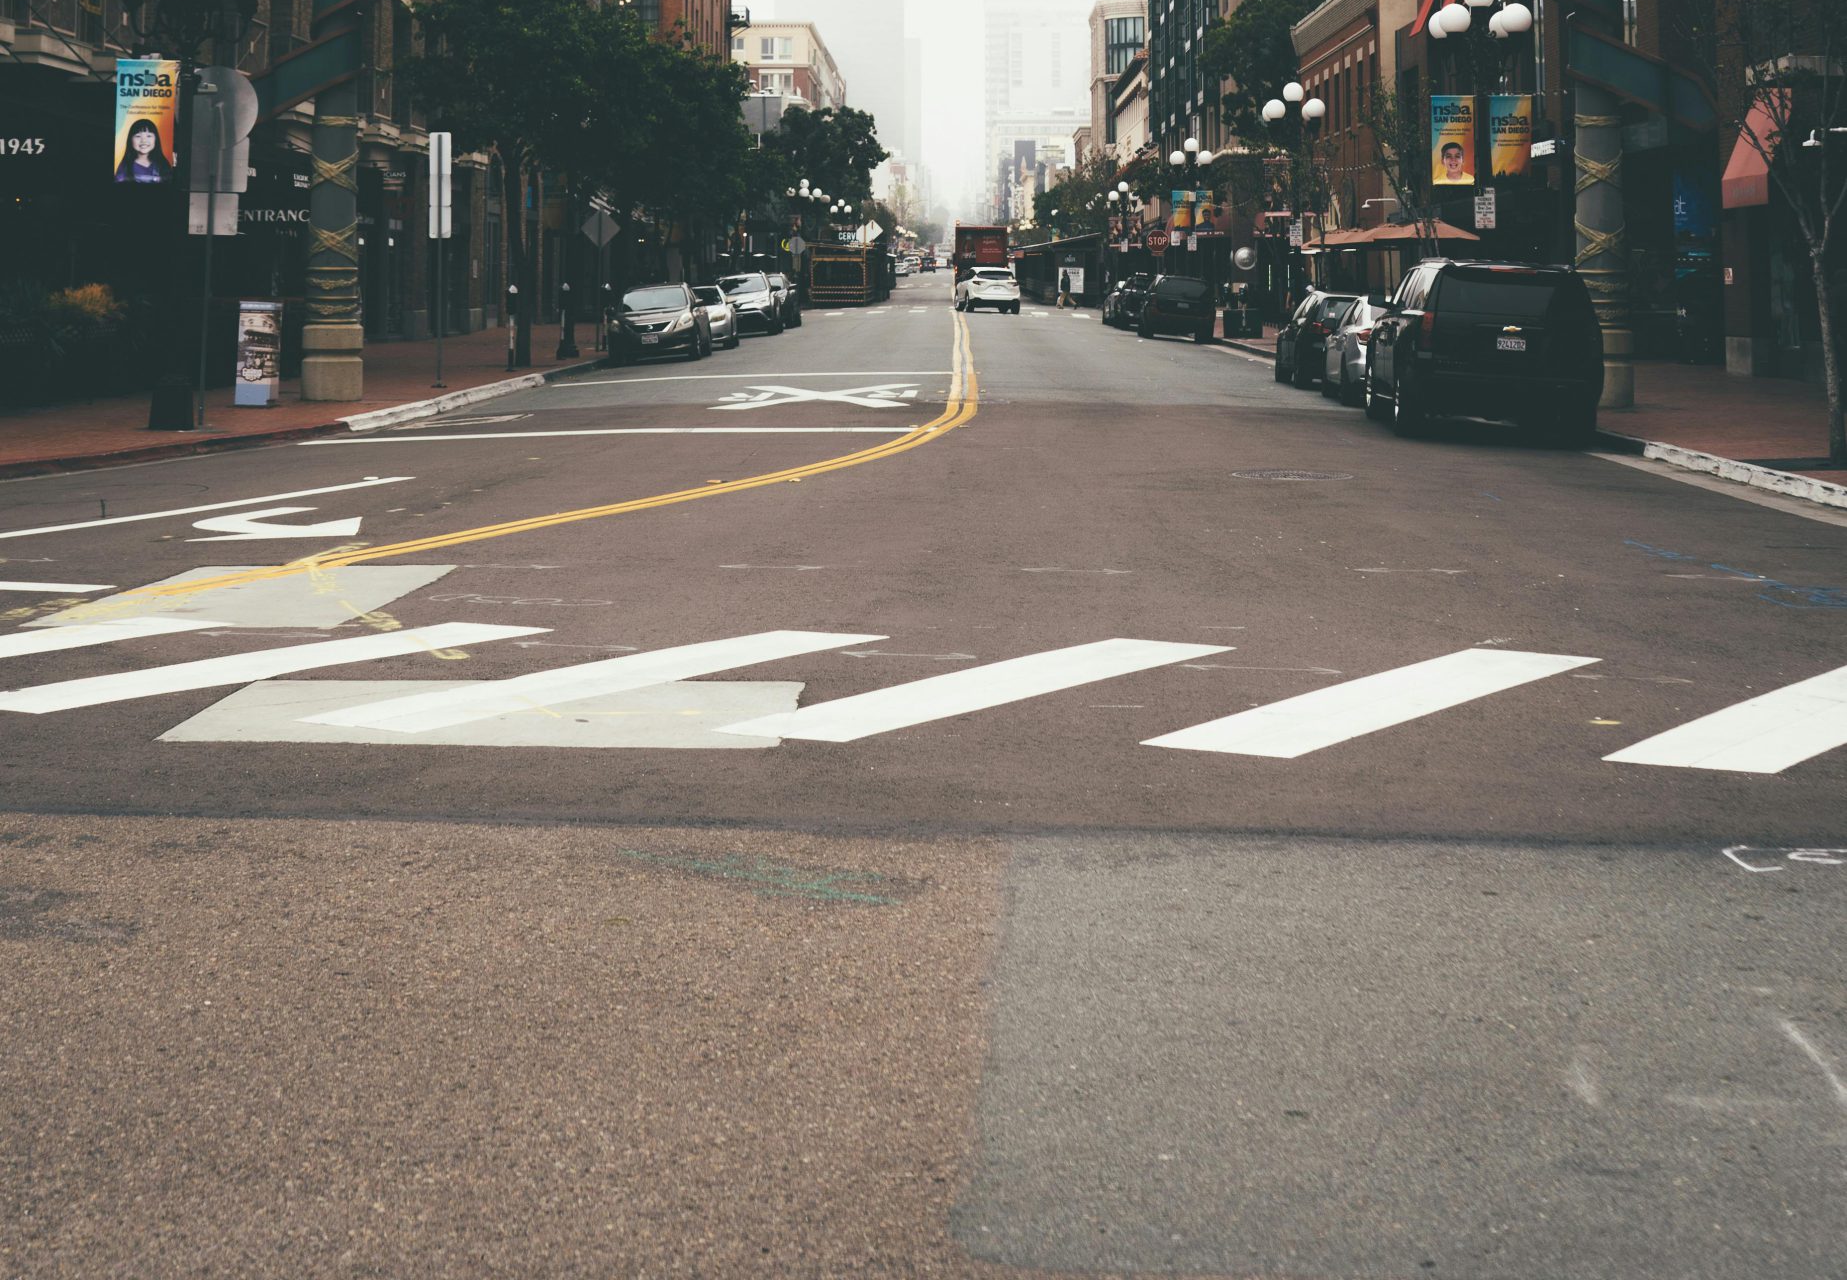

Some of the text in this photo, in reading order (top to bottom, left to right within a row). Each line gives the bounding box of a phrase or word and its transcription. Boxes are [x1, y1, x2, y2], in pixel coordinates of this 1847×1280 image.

[120, 69, 172, 87] nsba
[120, 87, 173, 98] SAN DIEGO
[1433, 102, 1472, 116] nsba
[1491, 113, 1530, 127] nsba
[1492, 126, 1530, 134] SAN DIEGO
[0, 138, 45, 155] 1945
[1148, 236, 1167, 246] STOP
